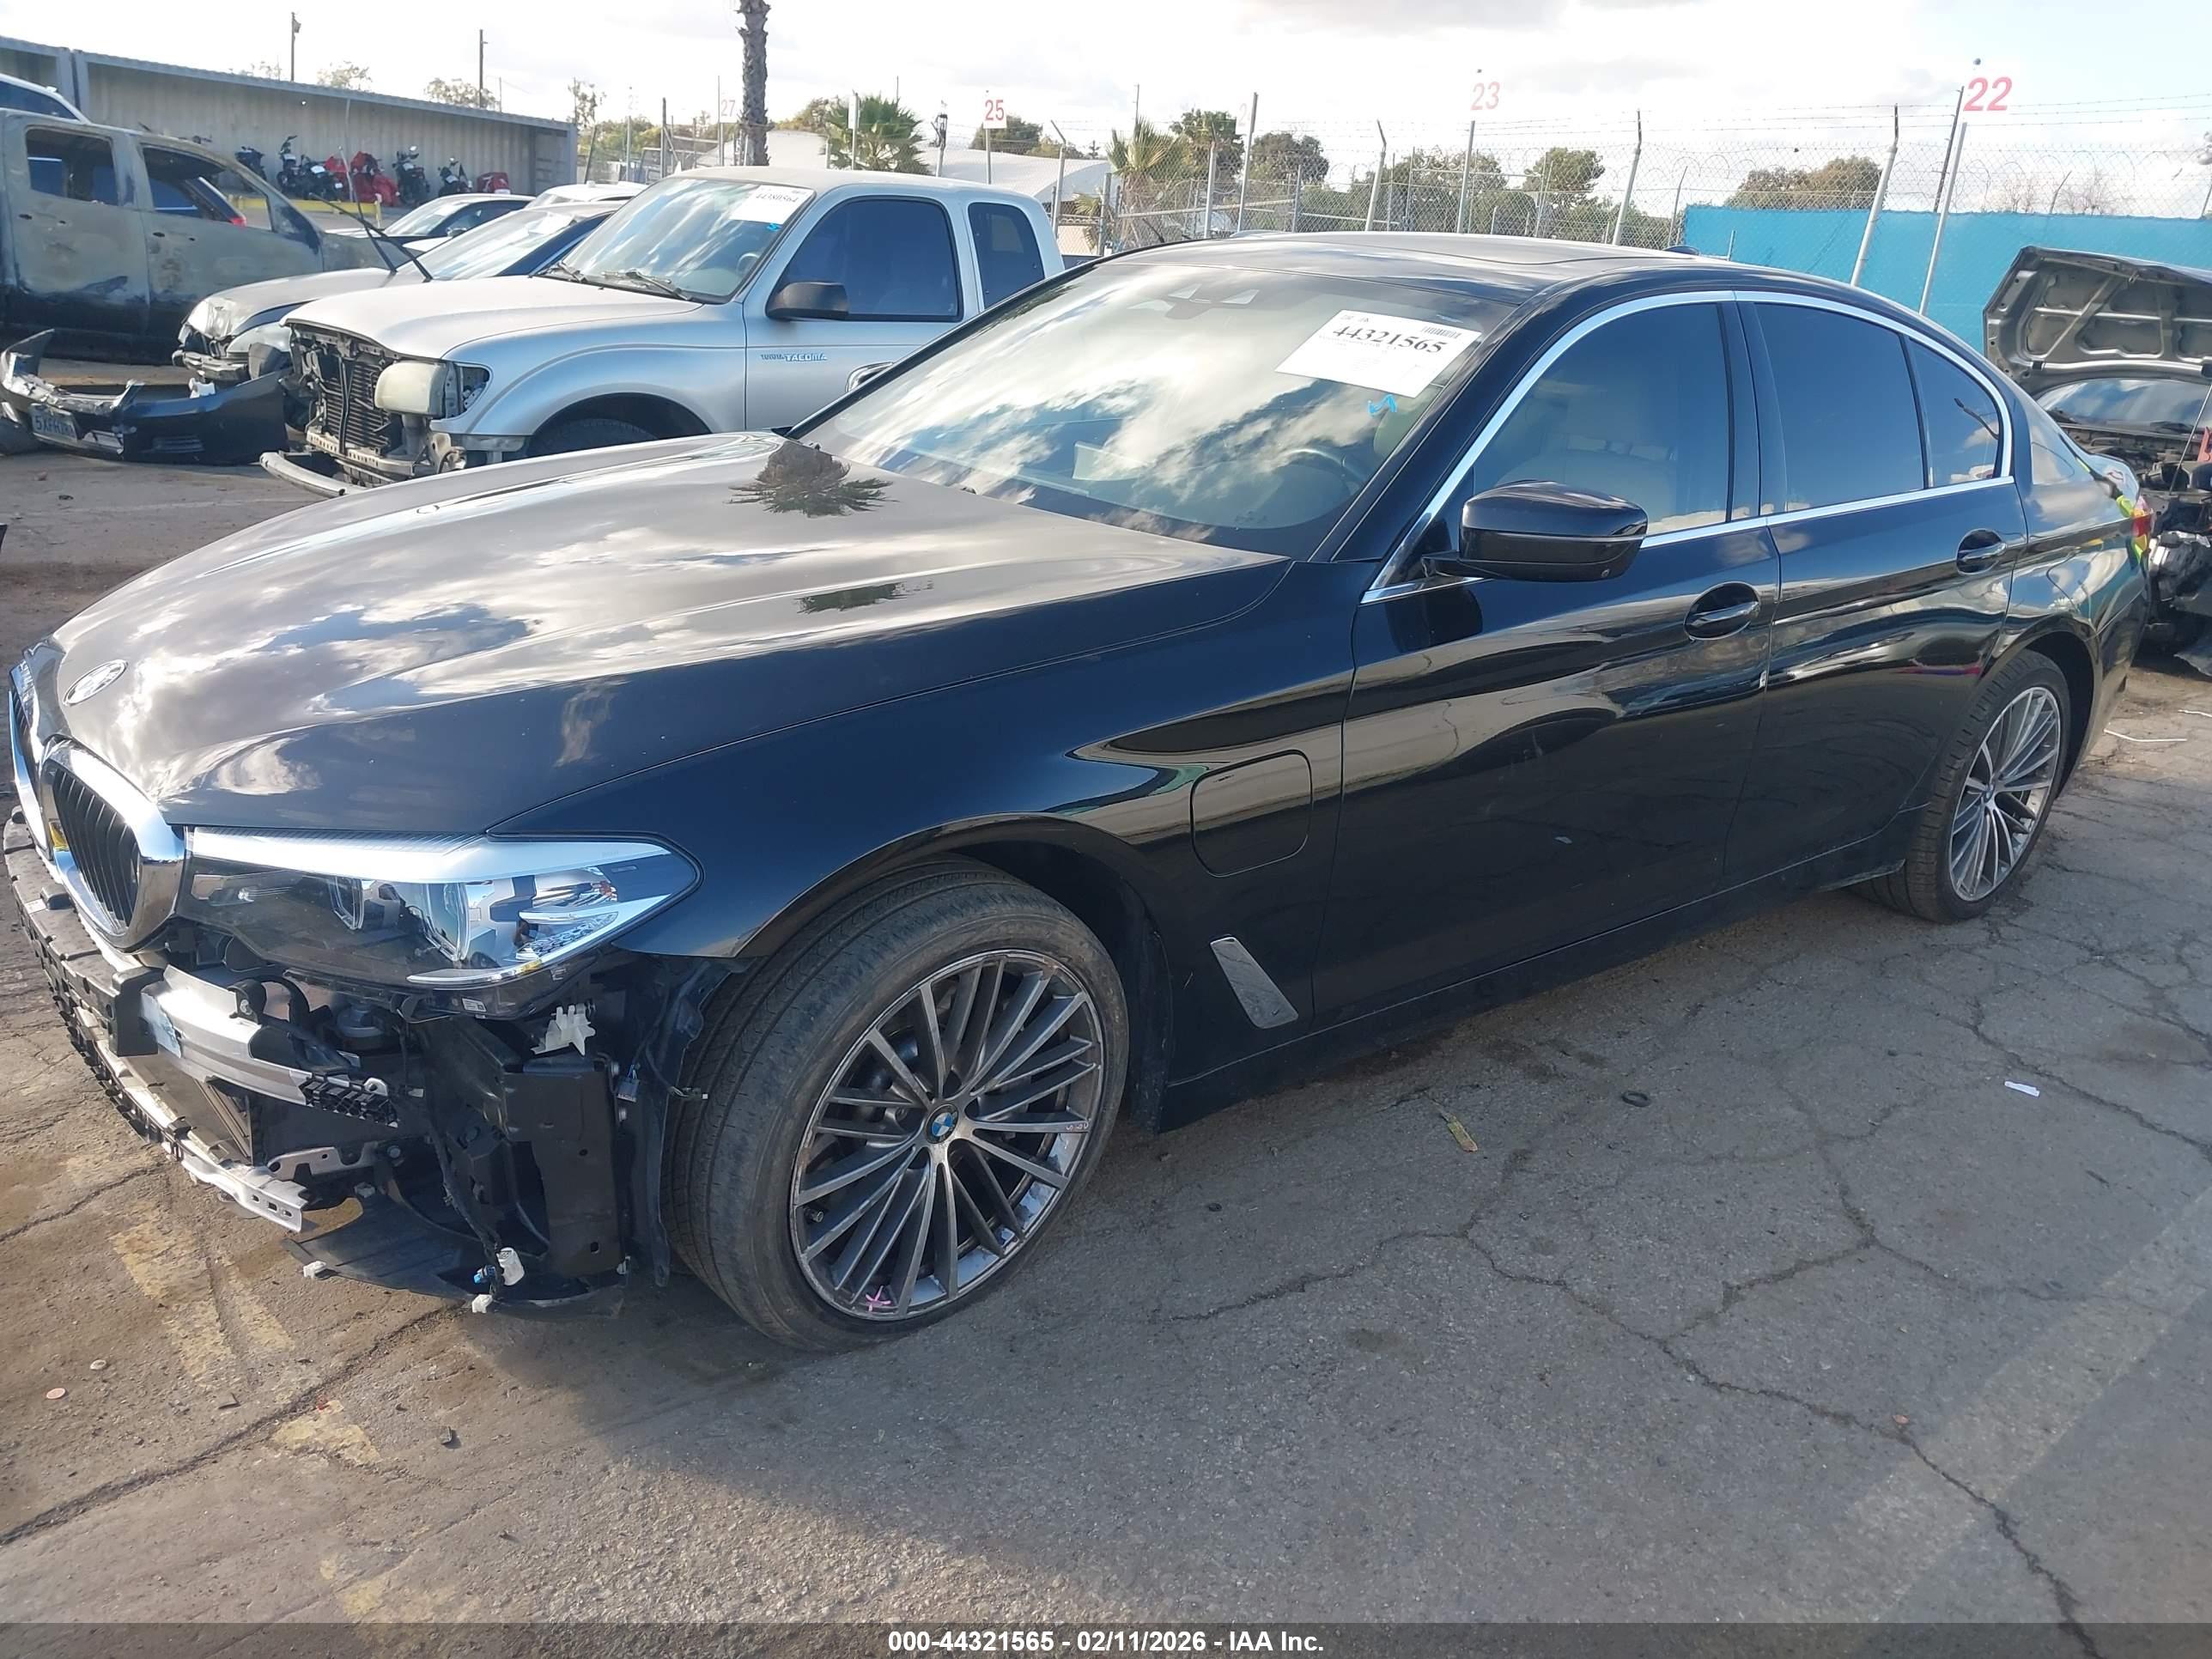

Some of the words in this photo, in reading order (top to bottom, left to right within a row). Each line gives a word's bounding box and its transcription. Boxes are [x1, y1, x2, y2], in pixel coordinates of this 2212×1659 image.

[1470, 81, 1501, 111] 23
[1963, 76, 2013, 112] 22
[721, 99, 736, 118] 27
[985, 99, 1005, 121] 25
[1333, 325, 1448, 354] 44321565
[786, 353, 828, 362] TACOMA
